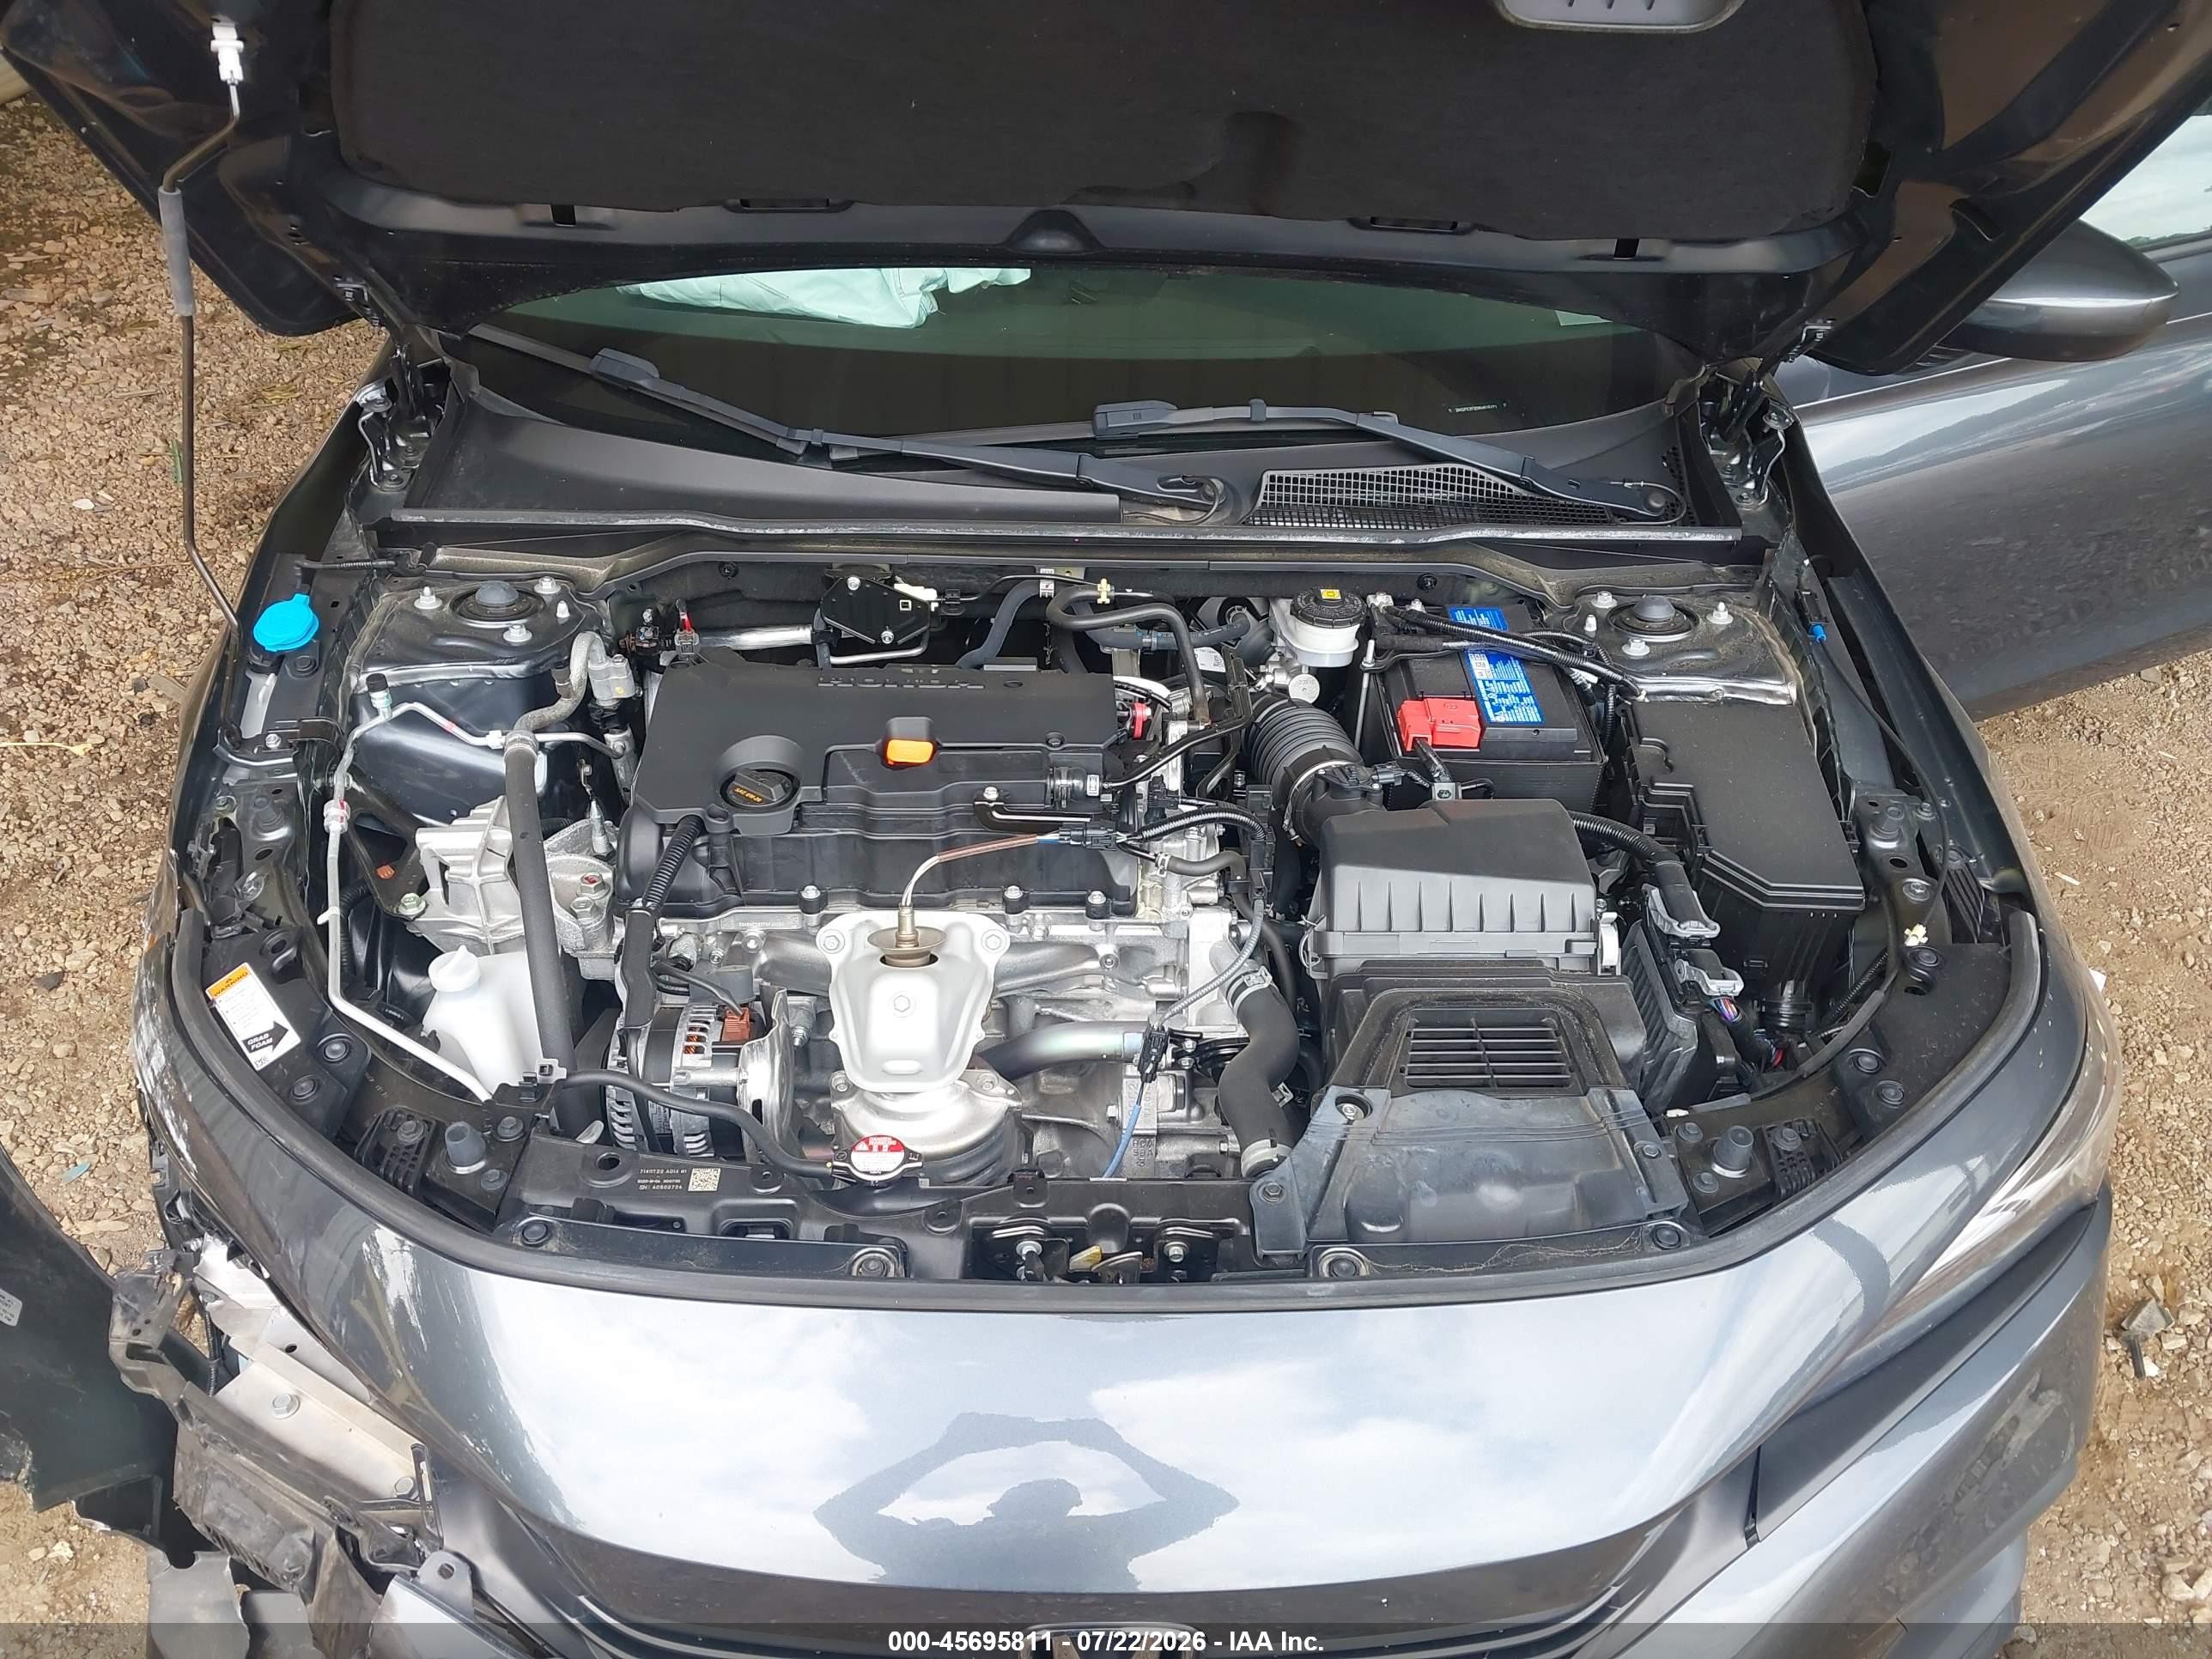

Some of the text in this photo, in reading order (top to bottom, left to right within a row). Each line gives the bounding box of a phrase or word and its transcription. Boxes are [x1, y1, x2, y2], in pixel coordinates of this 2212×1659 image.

[213, 971, 248, 997] WARNING
[247, 1033, 270, 1045] GRAB
[251, 1037, 273, 1050] FOAM
